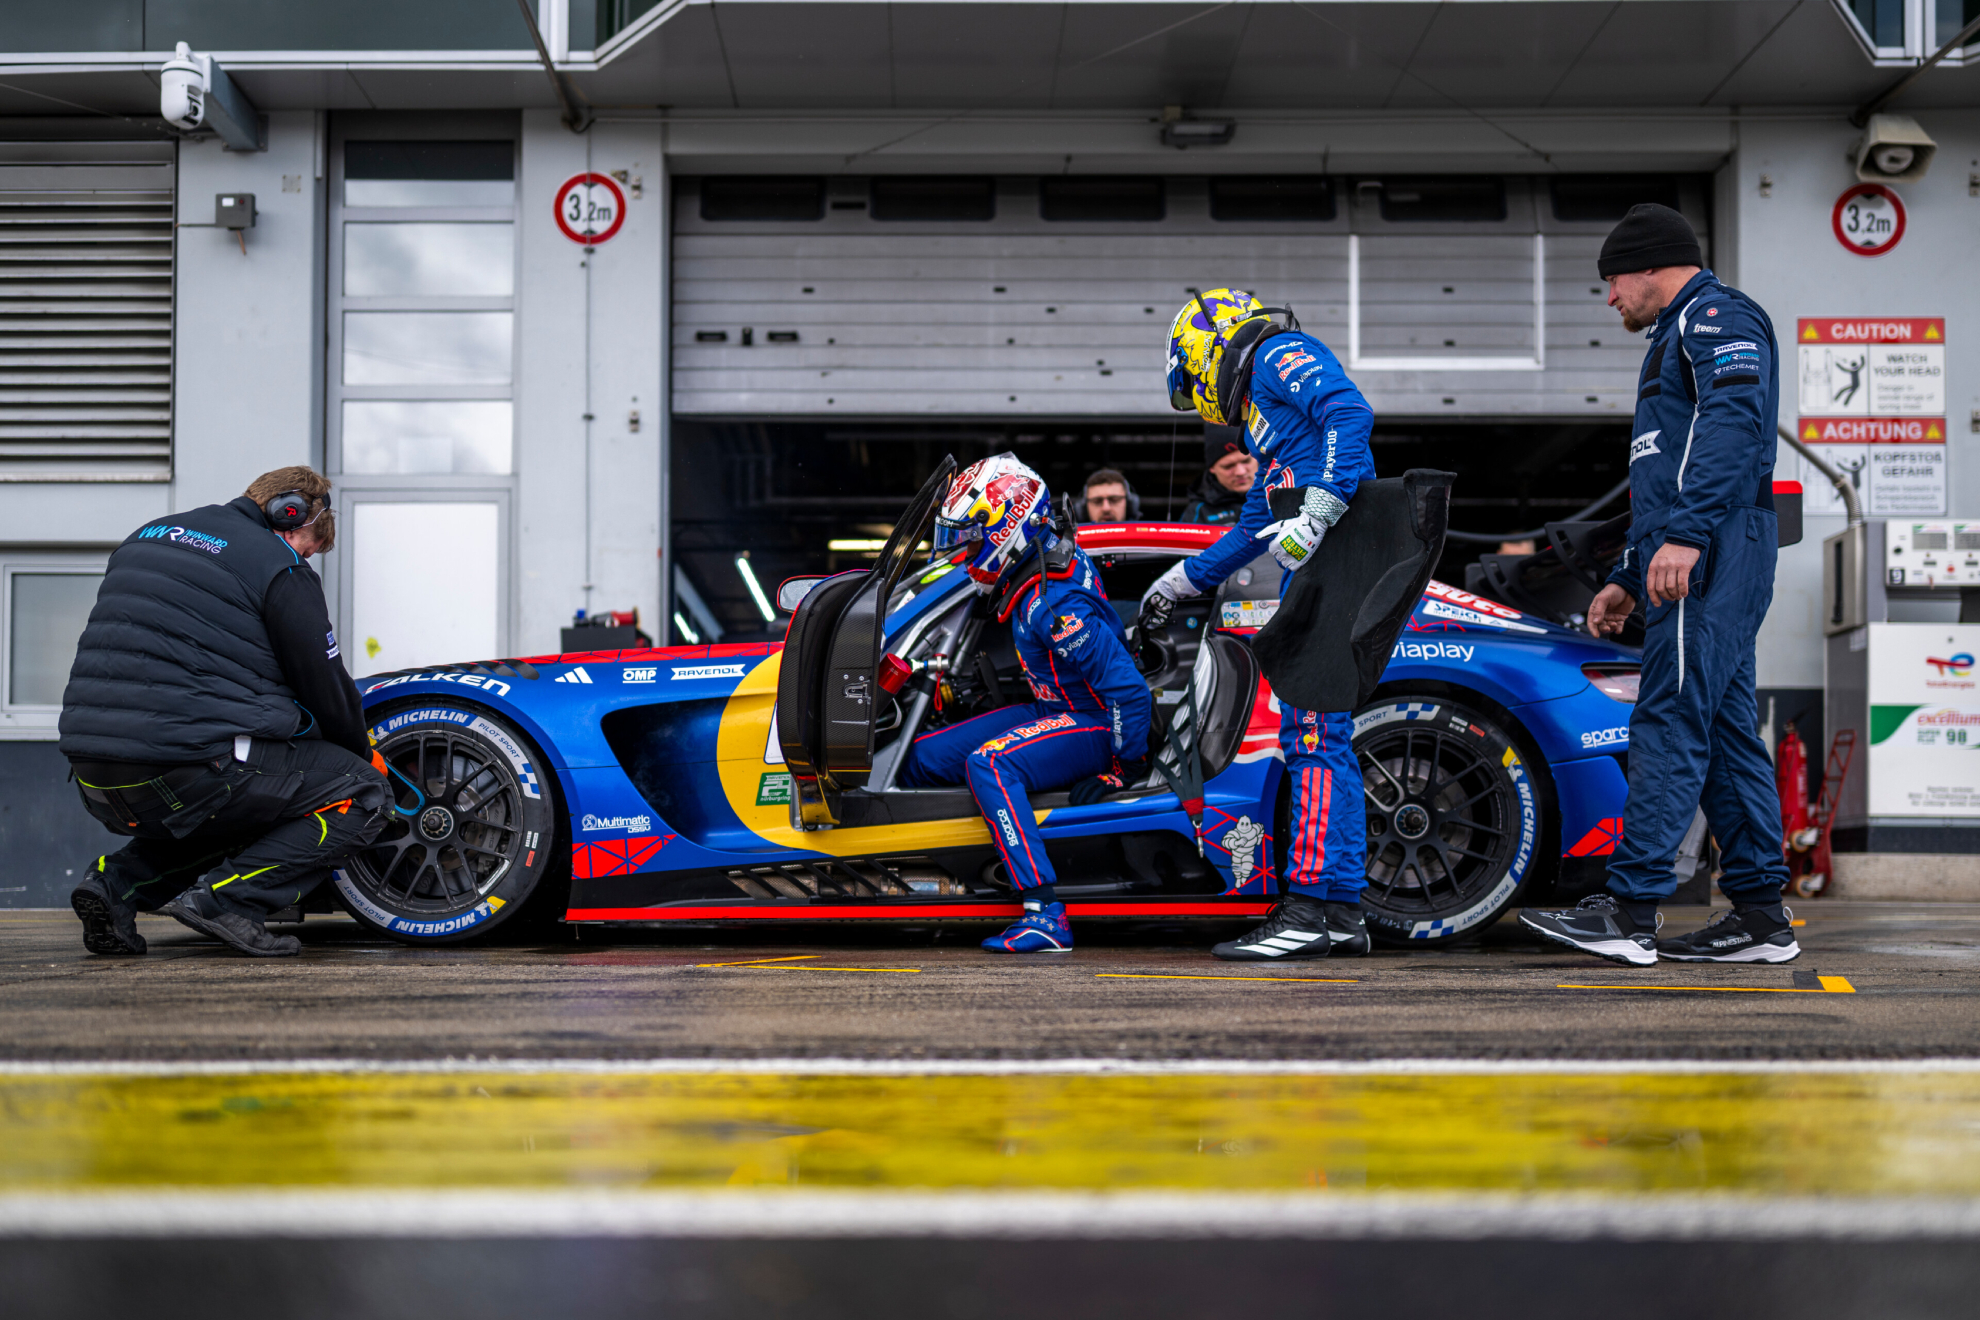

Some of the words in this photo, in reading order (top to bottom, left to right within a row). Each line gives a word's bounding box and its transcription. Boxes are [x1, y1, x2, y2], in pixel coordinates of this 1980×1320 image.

[1847, 203, 1891, 233] 3,2m
[1831, 323, 1911, 339] CAUTION
[1887, 354, 1927, 364] WATCH
[1874, 366, 1904, 377] YOUR
[1909, 366, 1941, 377] HEAD
[1823, 422, 1922, 439] ACHTUNG
[1882, 466, 1933, 477] GEFAHR
[988, 513, 1018, 547] Red
[1010, 486, 1036, 521] Bull
[1078, 527, 1127, 535] ERSTAPPEN
[179, 535, 222, 554] RACING
[1286, 536, 1307, 557] FILTER
[1067, 619, 1084, 635] Bull
[623, 669, 657, 681] OMP
[678, 667, 738, 677] RAVENOL
[363, 673, 511, 697] FALKEN
[388, 709, 469, 731] MICHELIN
[1014, 721, 1050, 739] Red
[1046, 713, 1077, 731] Bull
[1359, 711, 1388, 728] SPORT
[478, 722, 501, 738] PILOT
[498, 736, 520, 759] SPORT
[1580, 726, 1629, 748] sparc
[1946, 729, 1967, 745] 98
[597, 814, 650, 828] Multimatic
[997, 808, 1019, 847] sparco
[1513, 782, 1535, 876] MICHELIN
[343, 885, 366, 910] SPORT
[1488, 884, 1510, 907] PILOT
[362, 906, 385, 921] PILOT
[396, 911, 476, 933] MICHELIN
[1462, 900, 1490, 925] SPORT
